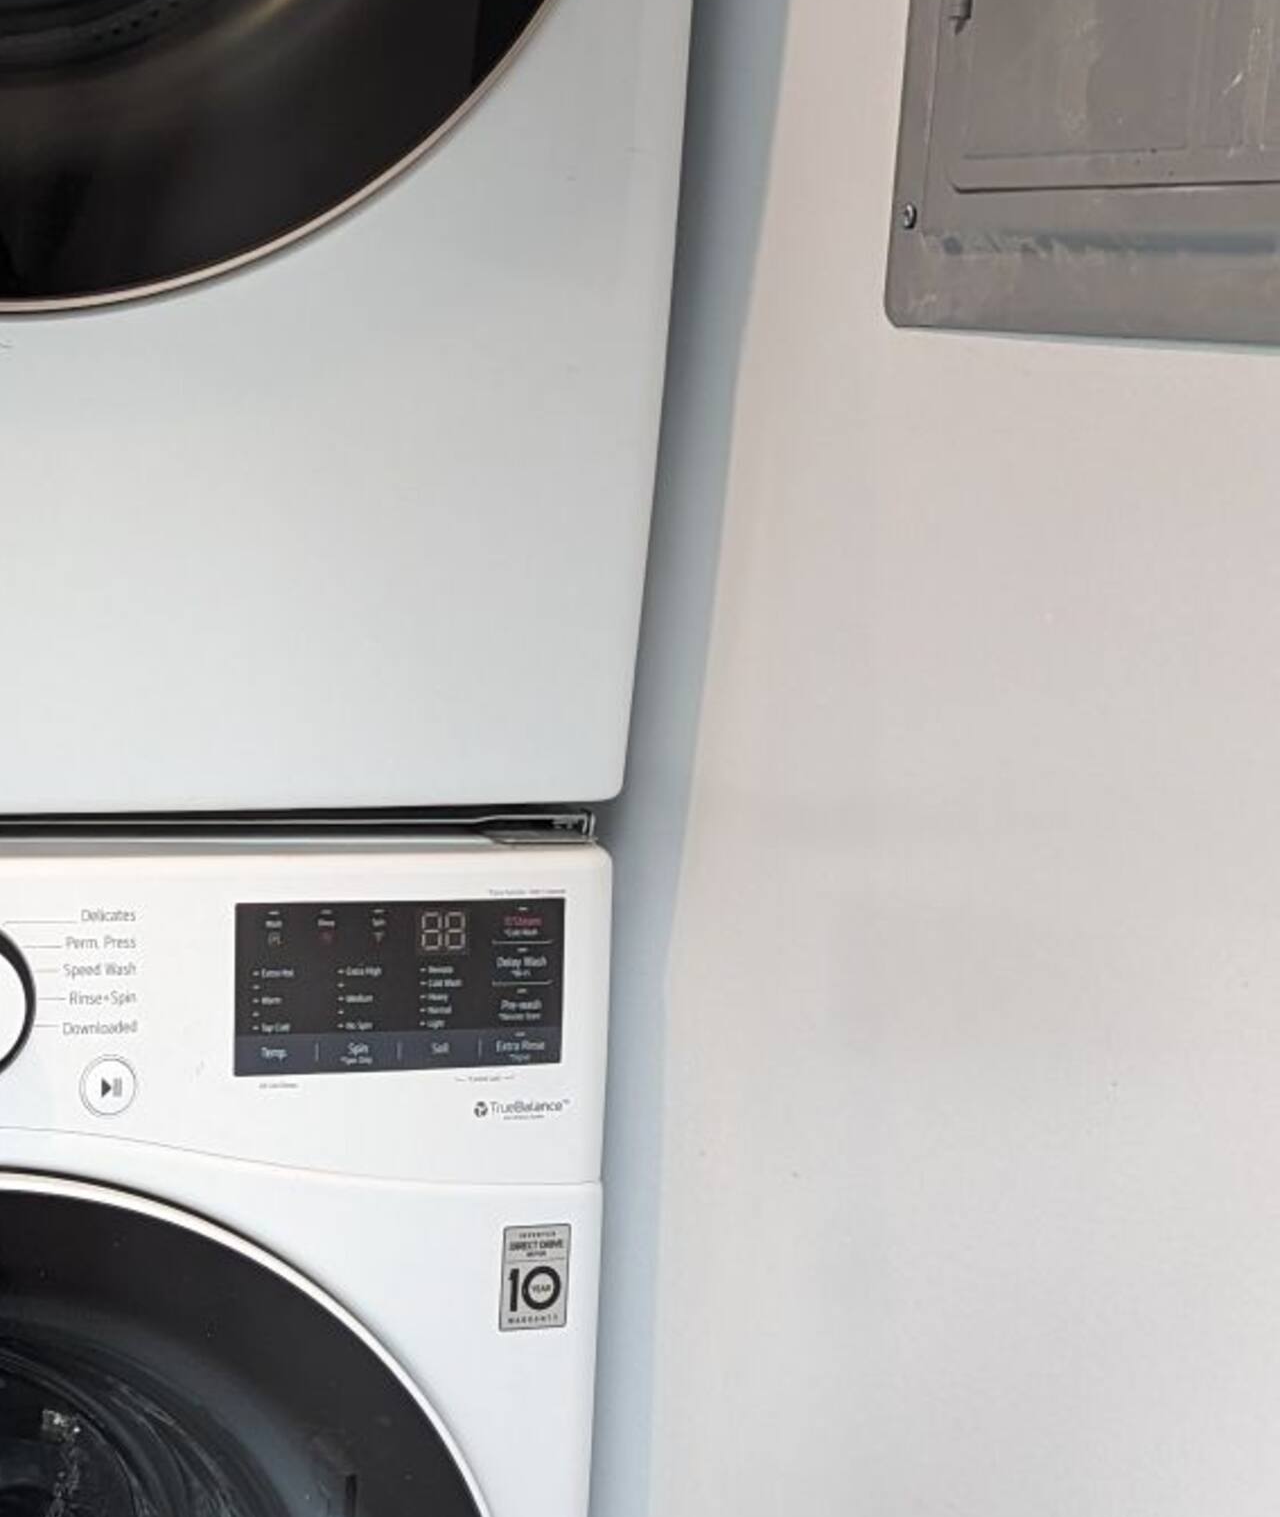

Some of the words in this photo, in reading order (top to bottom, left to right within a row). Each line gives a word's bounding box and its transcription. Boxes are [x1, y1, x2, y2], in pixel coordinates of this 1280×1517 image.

[80, 908, 137, 923] Delicates
[66, 935, 100, 950] Perm.
[104, 935, 137, 950] Press
[63, 963, 102, 979] Speed
[105, 963, 137, 976] Wash
[69, 990, 137, 1007] Rinse+Spin
[62, 1020, 138, 1036] Downloaded
[509, 1240, 539, 1251] DIRECT
[540, 1239, 564, 1250] DRIVE
[508, 1265, 562, 1313] 10
[531, 1282, 552, 1293] YEAR
